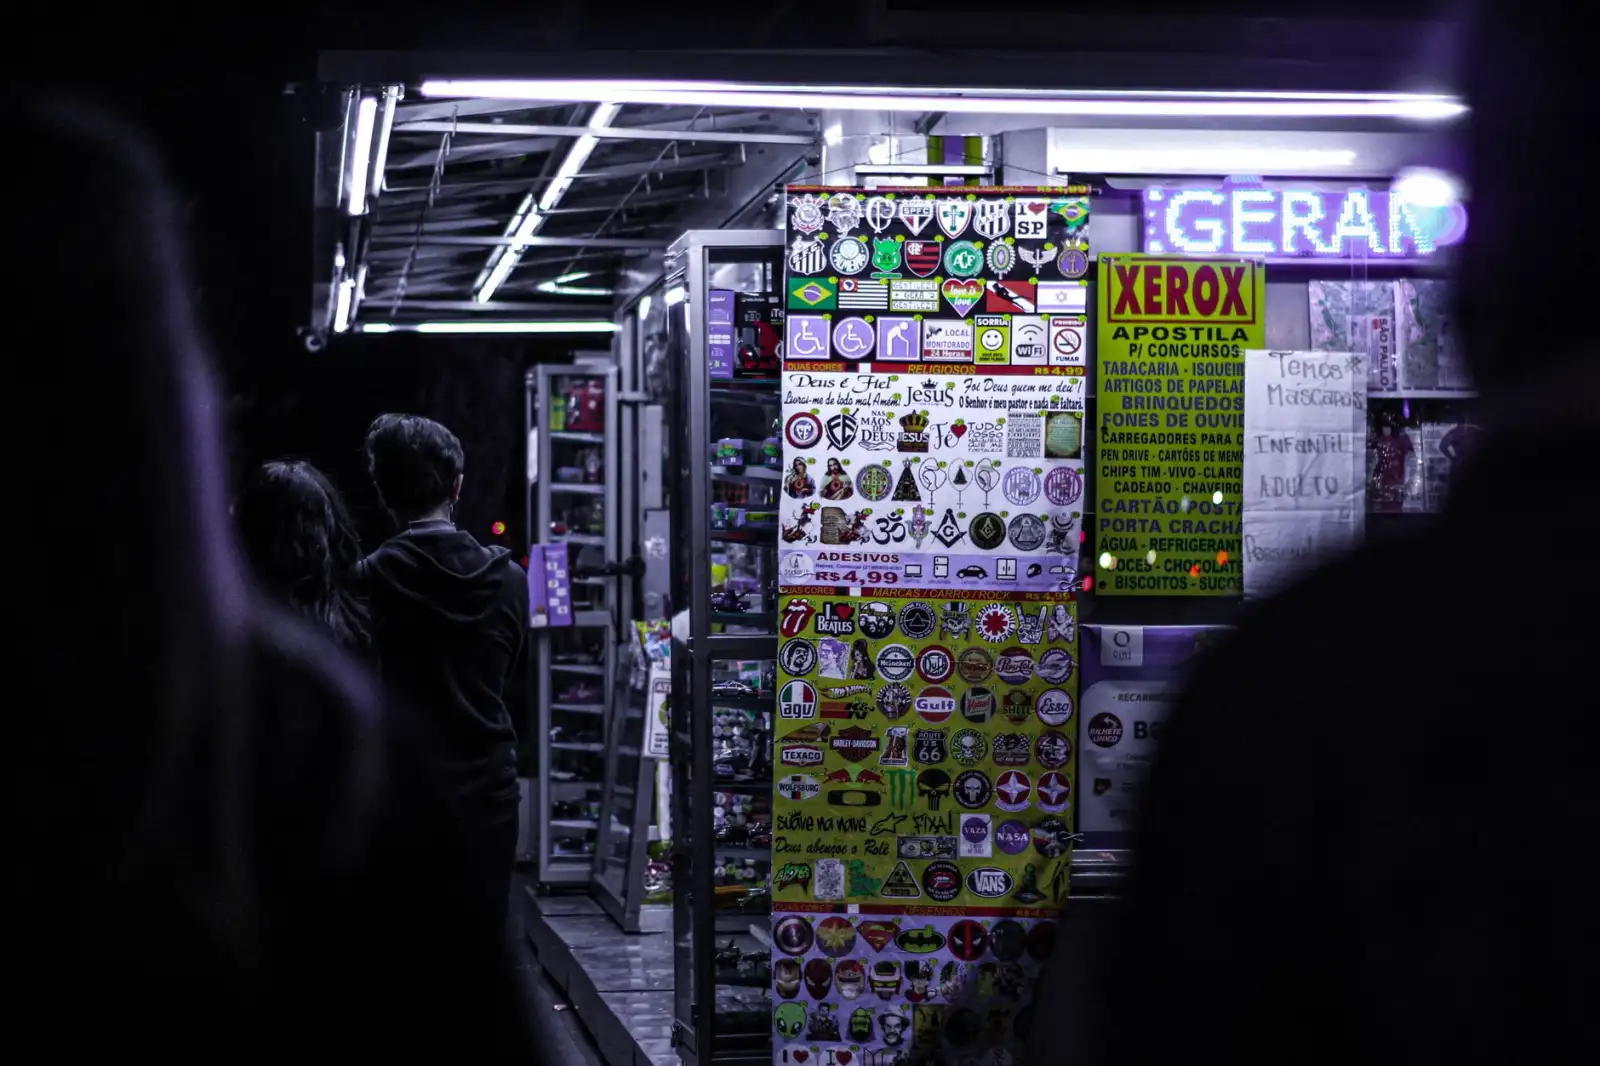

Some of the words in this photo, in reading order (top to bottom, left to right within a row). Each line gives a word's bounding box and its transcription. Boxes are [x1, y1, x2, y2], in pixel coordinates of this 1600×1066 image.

[903, 206, 931, 216] SPFC
[1018, 221, 1044, 235] SP
[1113, 264, 1248, 317] XEROX
[977, 318, 1009, 327] SORRIA
[945, 329, 970, 337] LOCAL
[1112, 326, 1249, 341] APOSTILA
[926, 341, 970, 349] MONITORADO
[1129, 344, 1143, 358] P/
[1148, 344, 1240, 358] CONCURSOS
[787, 363, 811, 371] DUAS
[812, 363, 844, 371] CORES
[907, 364, 977, 375] RELIGIOSOS
[1034, 367, 1049, 375] R$
[1050, 366, 1085, 376] 4,99
[1103, 361, 1179, 376] TABACARIA
[1379, 345, 1389, 386] PAULO
[789, 373, 836, 389] Deus
[851, 374, 892, 394] Fiel
[963, 377, 981, 394] Foi
[983, 377, 1008, 393] Deus
[1011, 384, 1036, 396] quem
[1038, 384, 1053, 393] me
[1104, 378, 1162, 393] ARTIGOS
[1167, 379, 1184, 393] DE
[783, 390, 824, 406] Livrai-me
[825, 393, 835, 406] de
[836, 391, 853, 406] todo
[959, 396, 965, 409] O
[965, 396, 988, 409] Senhor
[988, 395, 993, 409] é
[993, 399, 1007, 409] meu
[1008, 398, 1028, 411] pastor
[1033, 397, 1049, 409] nada
[1122, 396, 1244, 411] BRINQUEDOS
[861, 416, 892, 426] MÃOS
[967, 422, 1004, 431] TUDO
[1102, 412, 1160, 427] FONES
[1166, 413, 1188, 428] DE
[861, 429, 895, 442] DEUS
[898, 431, 931, 443] JESUS
[967, 431, 1004, 439] POSSO
[1101, 432, 1196, 445] CARREGADORES
[1201, 433, 1232, 445] PARA
[1101, 449, 1119, 461] PEN
[1122, 449, 1149, 461] DRIVE
[1158, 447, 1200, 462] CARTÕES
[1203, 450, 1215, 462] DE
[1102, 465, 1136, 478] CHIPS
[1141, 466, 1161, 478] TIM
[1168, 466, 1196, 478] VIVO
[1203, 466, 1242, 479] CLARO
[1114, 480, 1171, 493] CADEADO
[1260, 472, 1339, 499] ADULTO
[1101, 496, 1180, 514] CARTÃO
[1100, 518, 1162, 533] PORTA
[1100, 534, 1137, 551] ÁGUA
[817, 551, 900, 563] ADESIVOS
[815, 571, 841, 582] R$
[842, 570, 899, 586] 4,99
[1115, 576, 1188, 590] BISCOITOS
[804, 586, 836, 596] CORES
[872, 587, 922, 599] MARCAS
[929, 588, 969, 600] CARRO
[974, 589, 1011, 600] ROCK
[817, 615, 853, 632] BEATLES
[783, 703, 813, 719] agv
[916, 698, 955, 711] Gulf
[1039, 697, 1069, 716] Esso
[832, 739, 877, 748] HARLEY-DAVIDSON
[784, 751, 821, 760] TEXACO
[919, 749, 941, 761] 66
[778, 783, 820, 792] WOLFSBURG
[963, 826, 986, 835] VAZA
[996, 831, 1029, 842] NASA
[775, 836, 802, 853] Deus
[973, 871, 1006, 894] VANS
